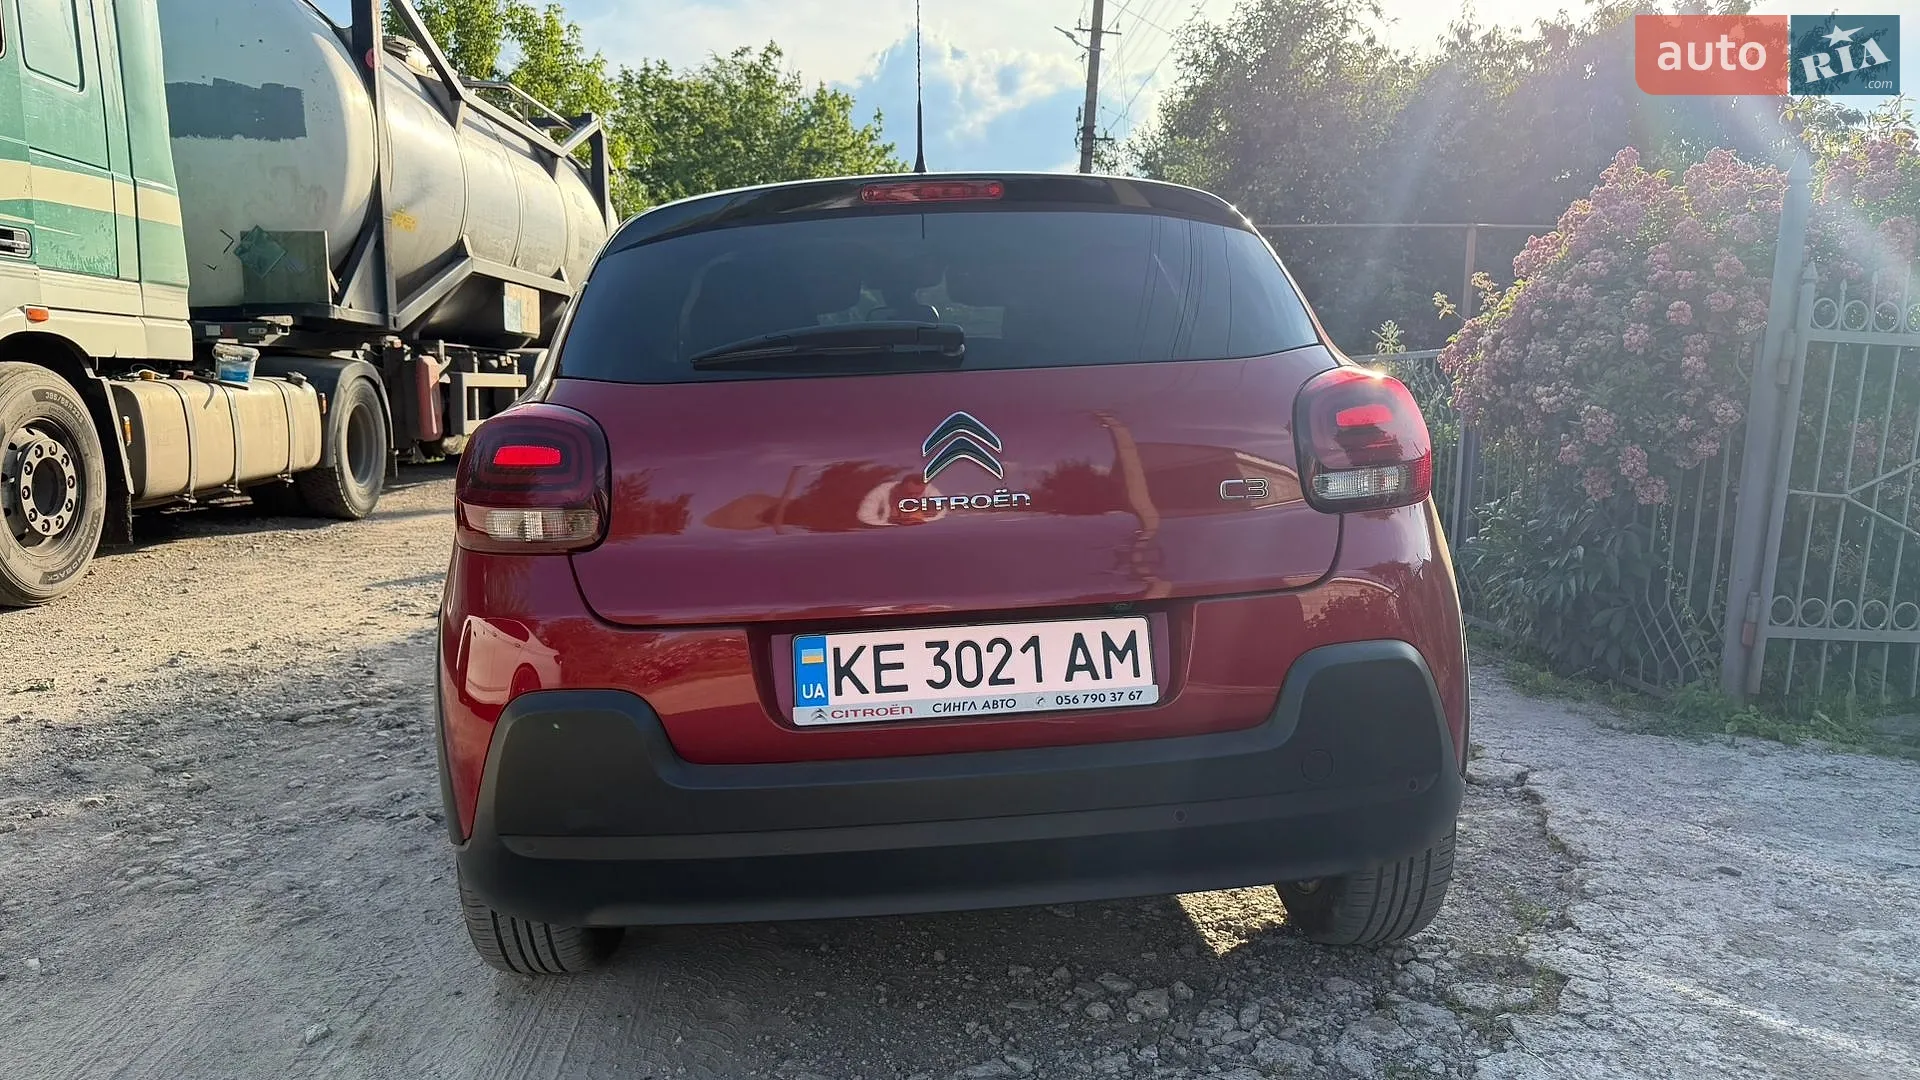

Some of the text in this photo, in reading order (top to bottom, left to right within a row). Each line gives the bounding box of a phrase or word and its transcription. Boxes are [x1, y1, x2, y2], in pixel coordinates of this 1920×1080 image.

[1219, 478, 1270, 500] C3
[833, 629, 1141, 697] KE 3021 AM
[802, 683, 825, 699] UA
[932, 690, 1143, 713] СИНГЛ АВТО 056 790 37 67
